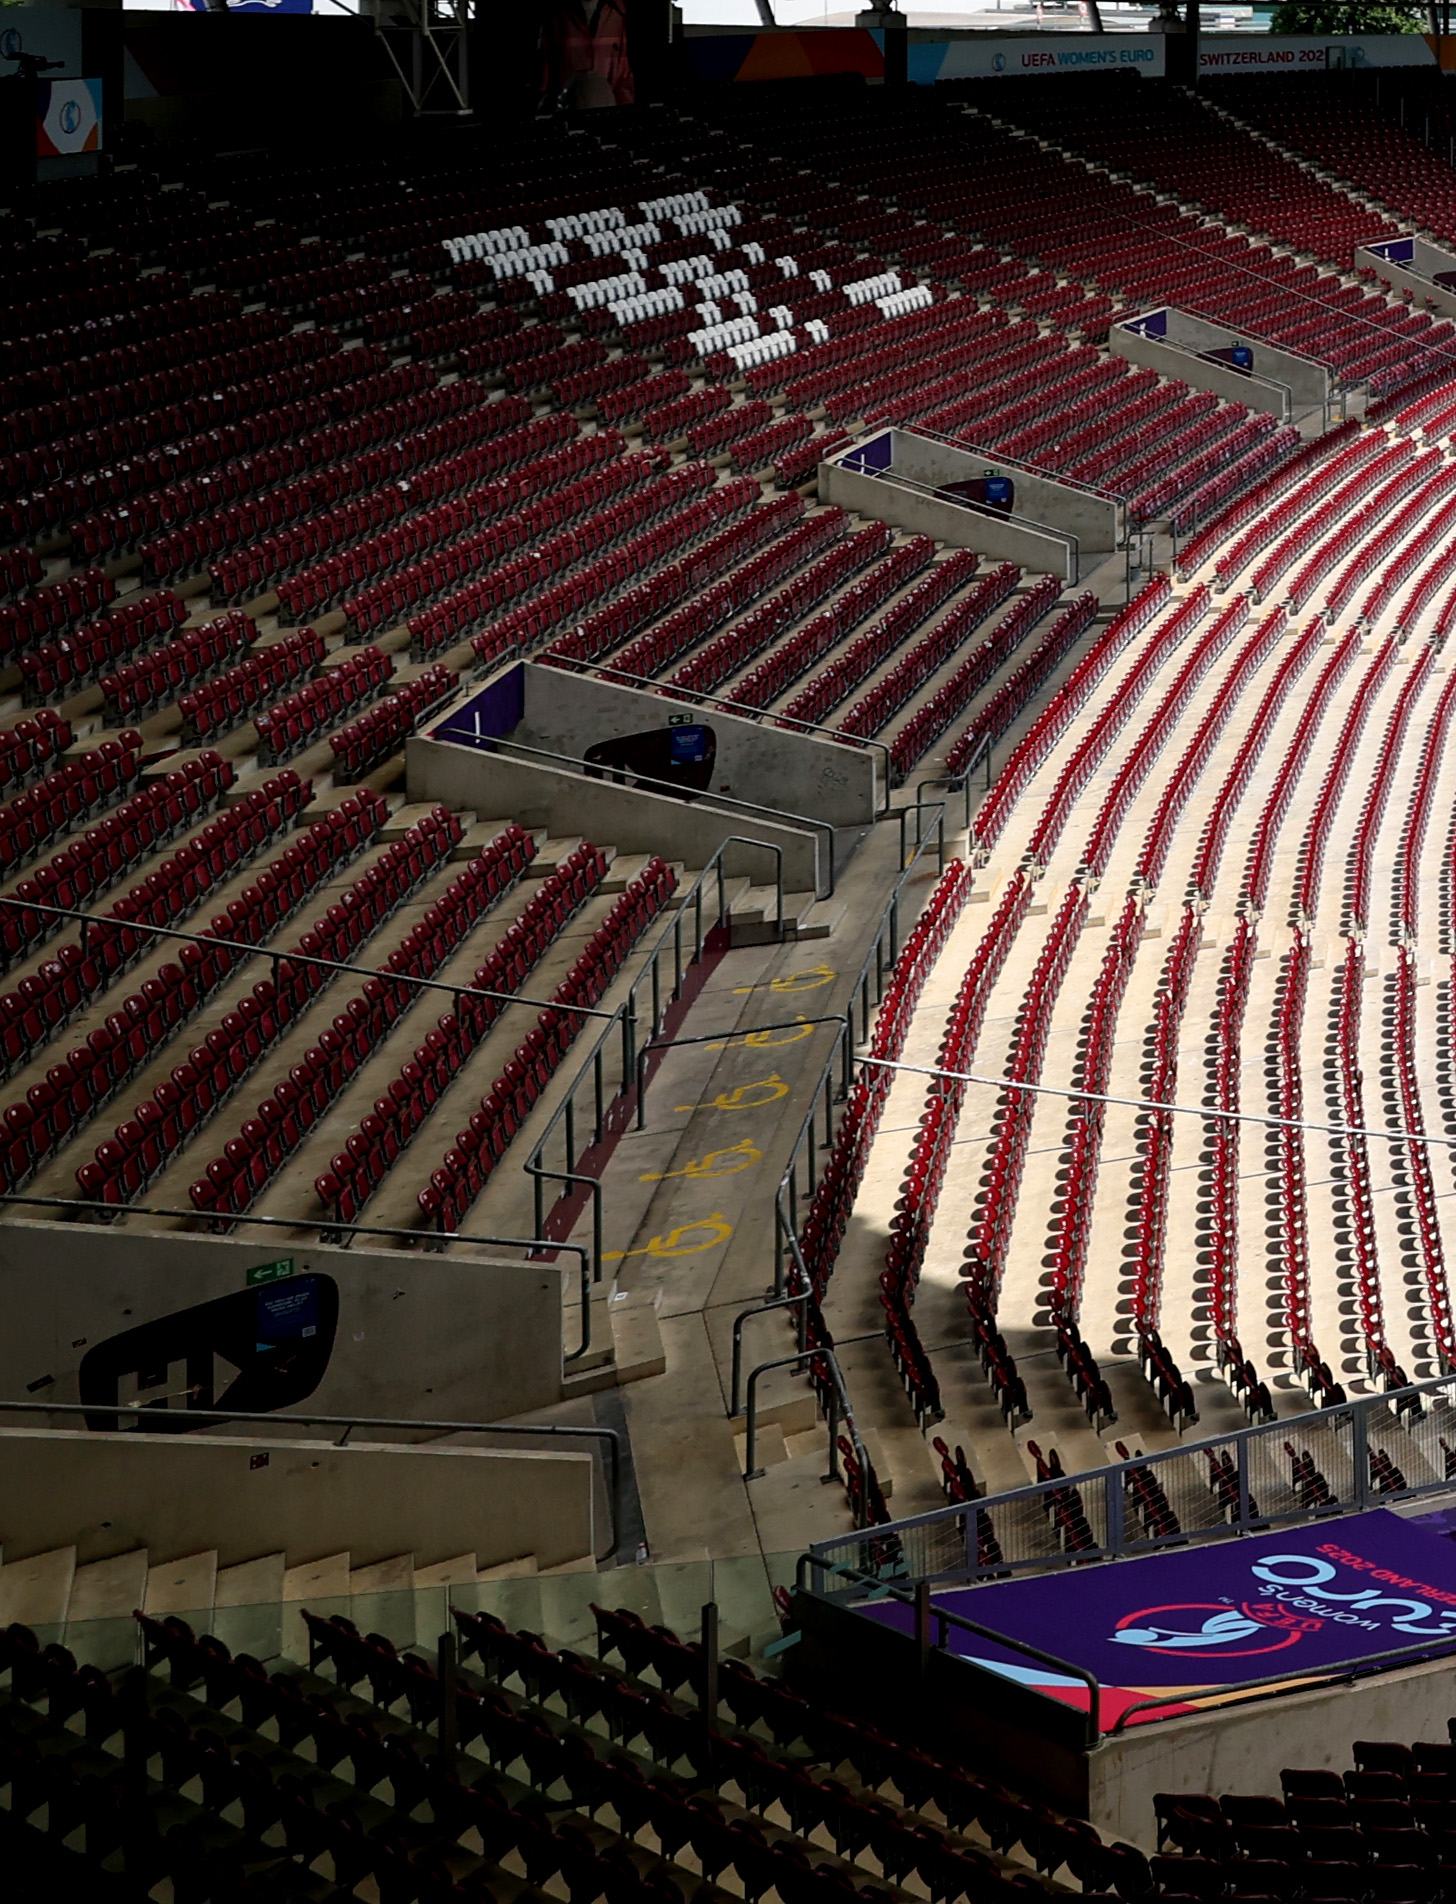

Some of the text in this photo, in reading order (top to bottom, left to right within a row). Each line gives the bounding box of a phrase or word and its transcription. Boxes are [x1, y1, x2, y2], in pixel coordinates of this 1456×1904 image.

[1022, 47, 1154, 67] UEFA WOMEN'S EURO
[1199, 48, 1325, 65] SWITZERLAND 202
[1315, 1542, 1378, 1572] 2025
[1257, 1584, 1382, 1632] women's
